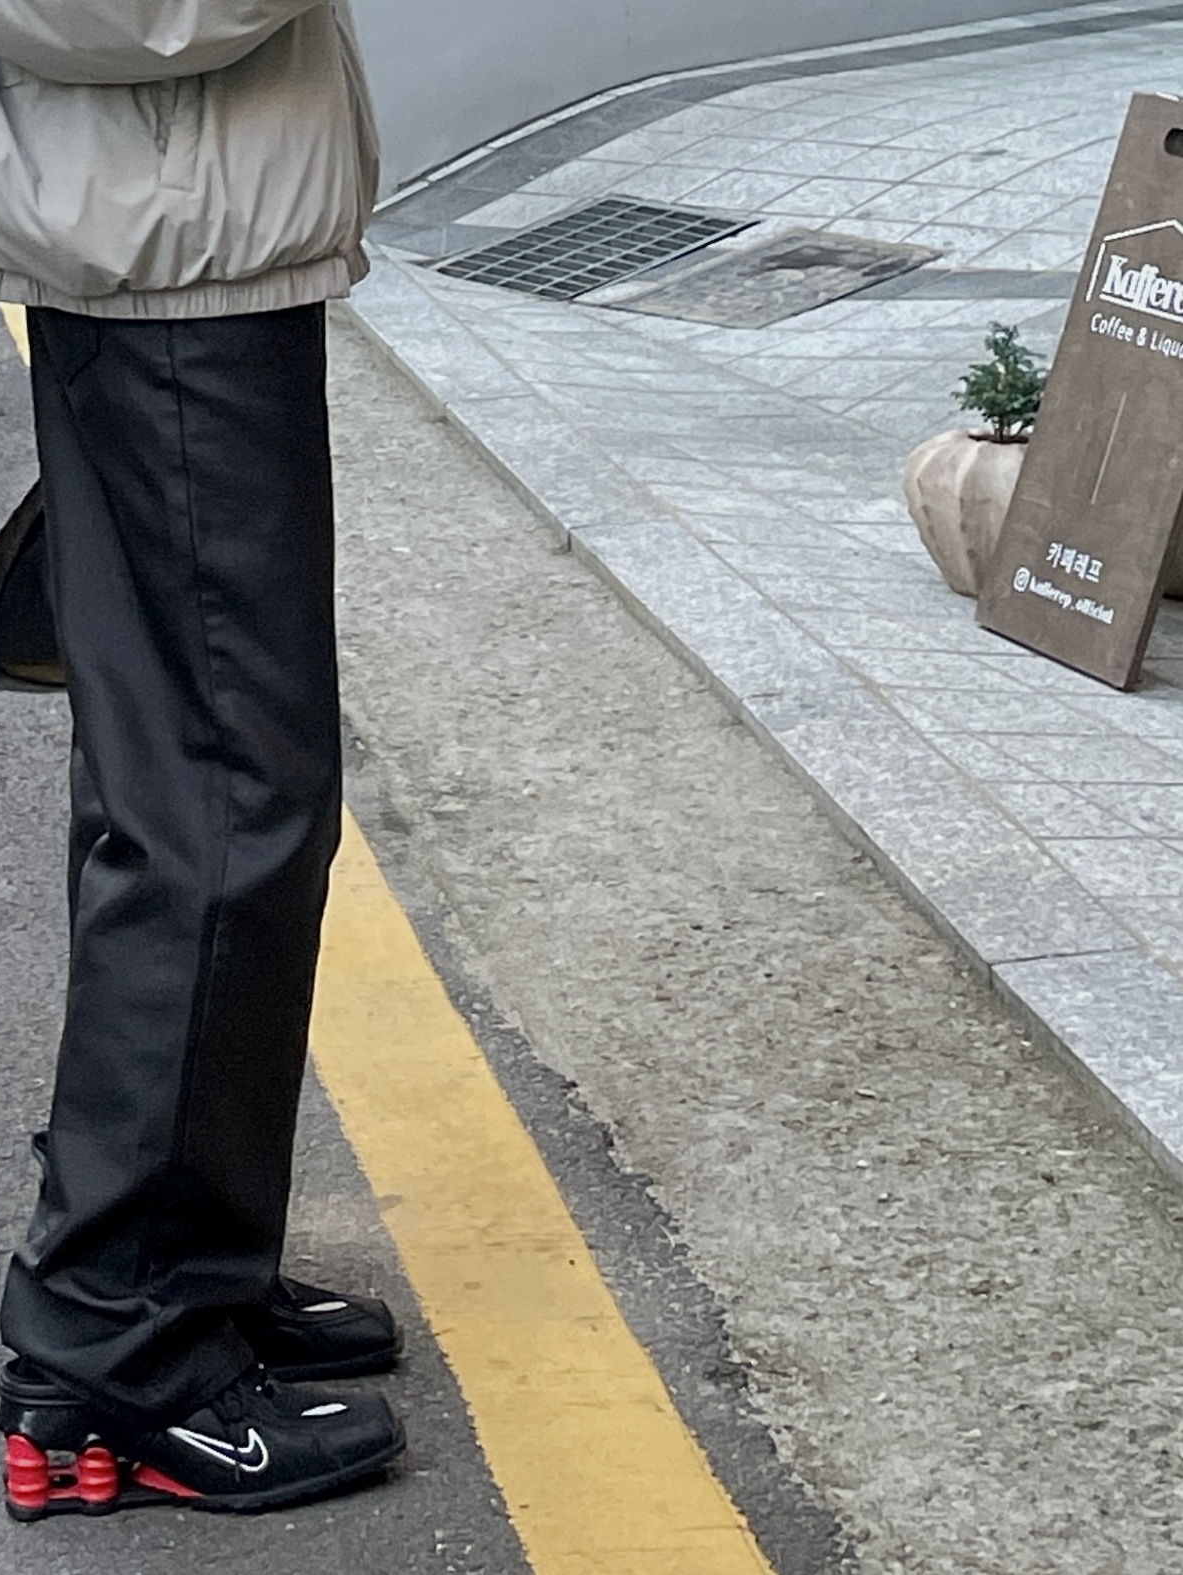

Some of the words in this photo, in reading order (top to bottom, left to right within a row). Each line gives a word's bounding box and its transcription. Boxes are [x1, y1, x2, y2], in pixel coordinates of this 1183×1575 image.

[1090, 313, 1134, 342] Coffee
[1137, 327, 1147, 346] &
[1046, 542, 1103, 583] 카페레프
